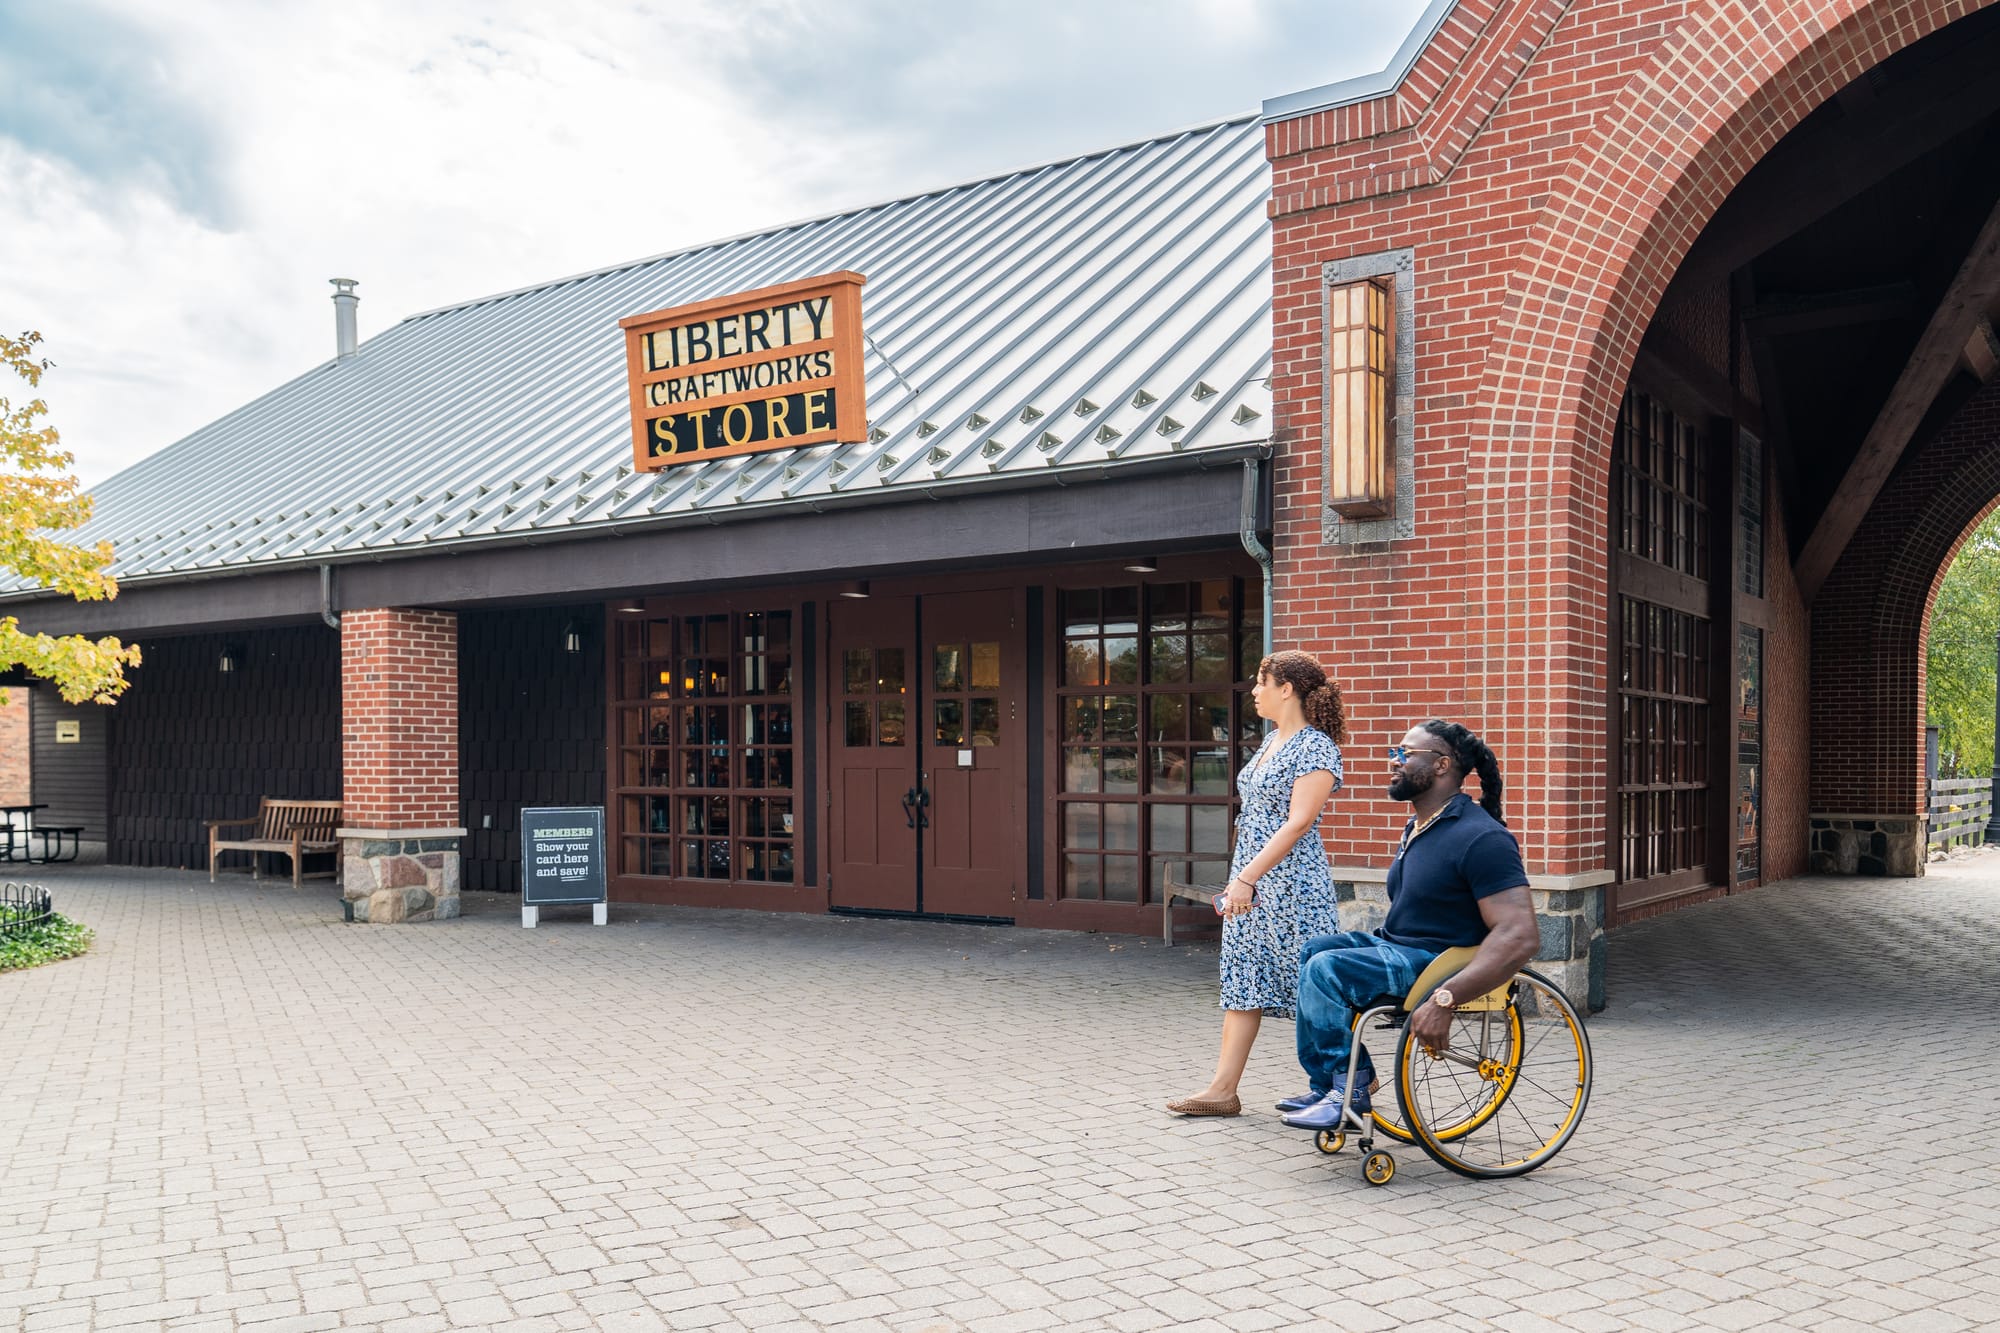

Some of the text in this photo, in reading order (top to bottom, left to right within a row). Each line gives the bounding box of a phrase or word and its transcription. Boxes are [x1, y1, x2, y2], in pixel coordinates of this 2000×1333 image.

[646, 296, 830, 372] LIBERTY
[650, 351, 832, 407] CRAFTWORKS
[654, 390, 830, 457] STORE
[533, 828, 593, 838] MEMBERS
[536, 843, 589, 852] Show your
[536, 854, 589, 864] card here
[536, 866, 589, 877] and save!
